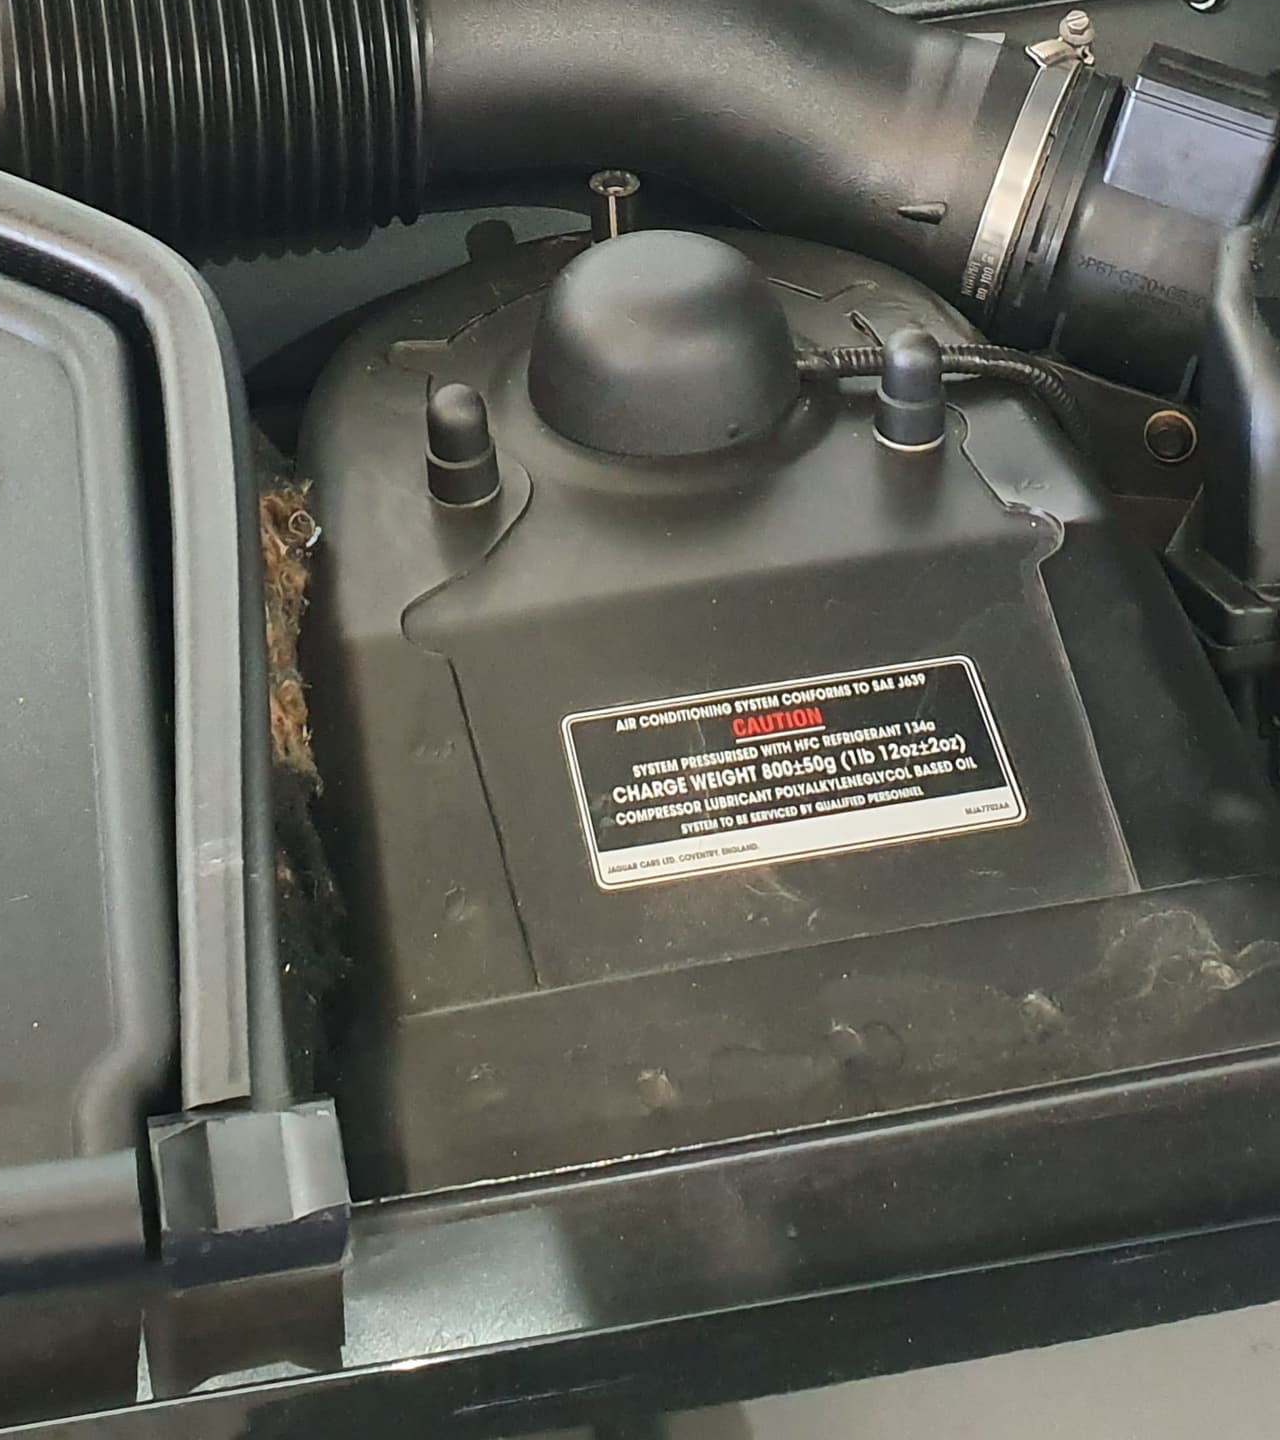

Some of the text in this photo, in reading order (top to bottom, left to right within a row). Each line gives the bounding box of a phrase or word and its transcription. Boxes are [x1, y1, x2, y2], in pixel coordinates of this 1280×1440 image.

[616, 673, 926, 732] AIR CONDITIONING SYSTEM CONFORMS TO SAE J639
[732, 706, 823, 737] CAUTION
[612, 733, 966, 803] CHARGE WEIGHT 800±50g (1lb 12oz±2oz)
[632, 720, 936, 778] SYSTEM PRESSURISED WITH HFC REFRIGERANT 134a
[616, 757, 978, 826] COMPRESSOR LUBRICANT POLYALKYLENEGLYCOL BASED OIL
[680, 786, 924, 835] SYSTEM TO BE SERVICED BY QUALIFIED PERSONNEL
[607, 863, 638, 874] JAGUAR
[639, 859, 661, 869] CARS
